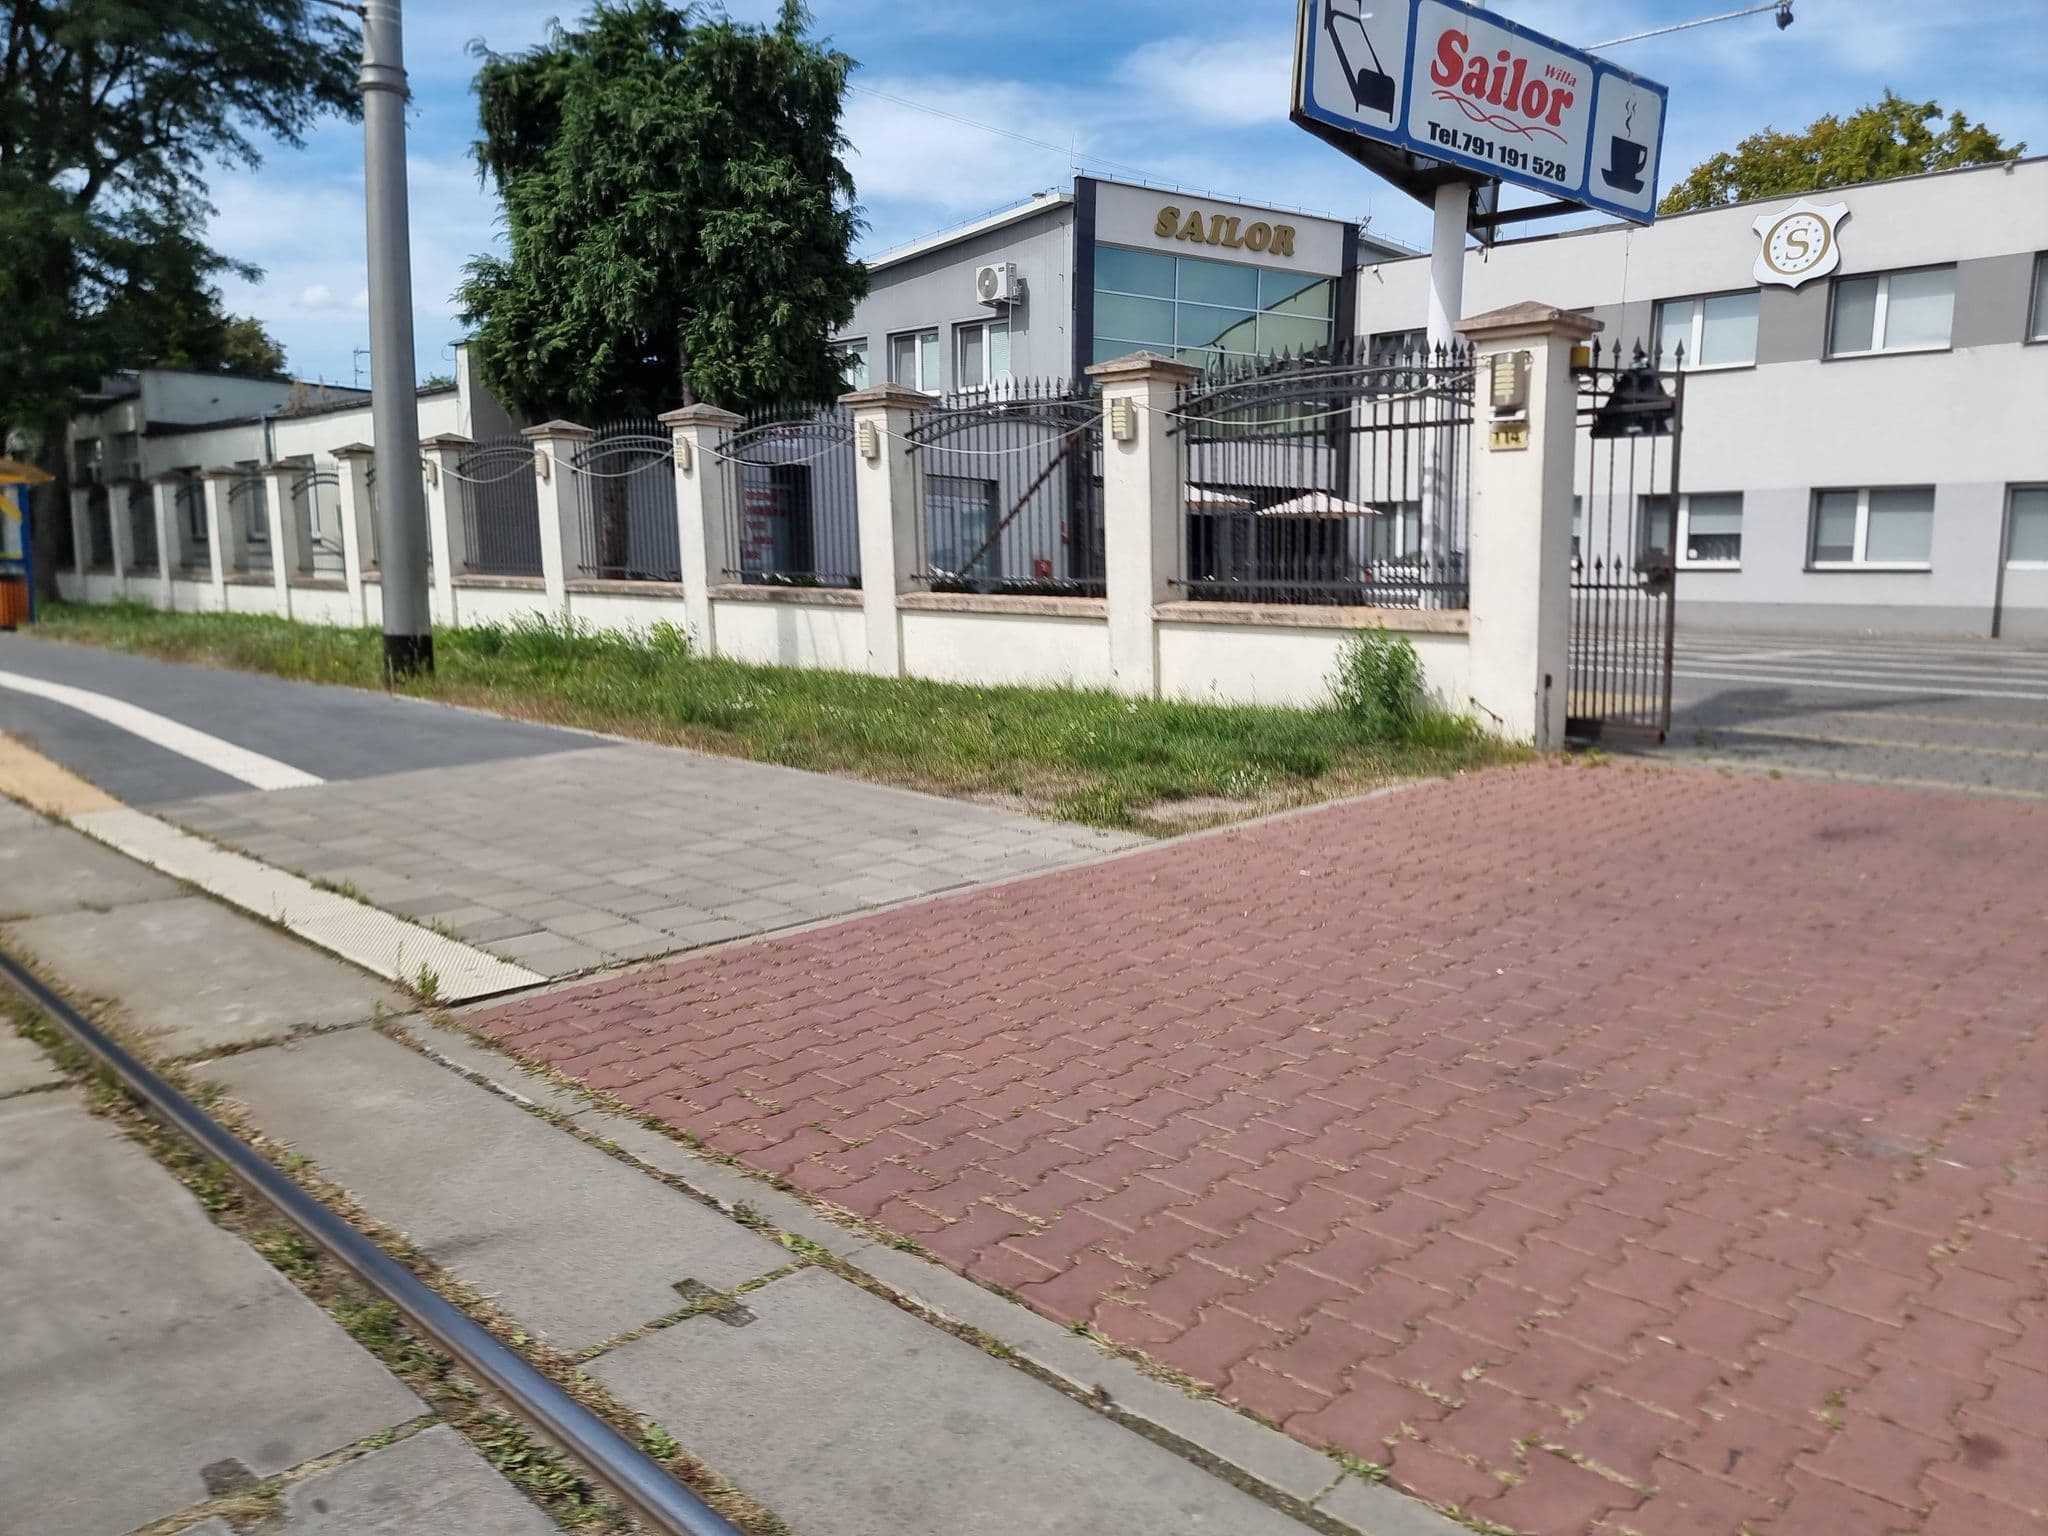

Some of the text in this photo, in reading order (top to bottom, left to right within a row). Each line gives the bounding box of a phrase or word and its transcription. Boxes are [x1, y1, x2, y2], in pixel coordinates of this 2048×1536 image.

[1430, 29, 1574, 127] Sailor
[1544, 64, 1577, 88] Willa
[1428, 121, 1567, 182] Tel.791 191 528
[1154, 205, 1296, 257] SAILOR
[1785, 228, 1809, 260] S
